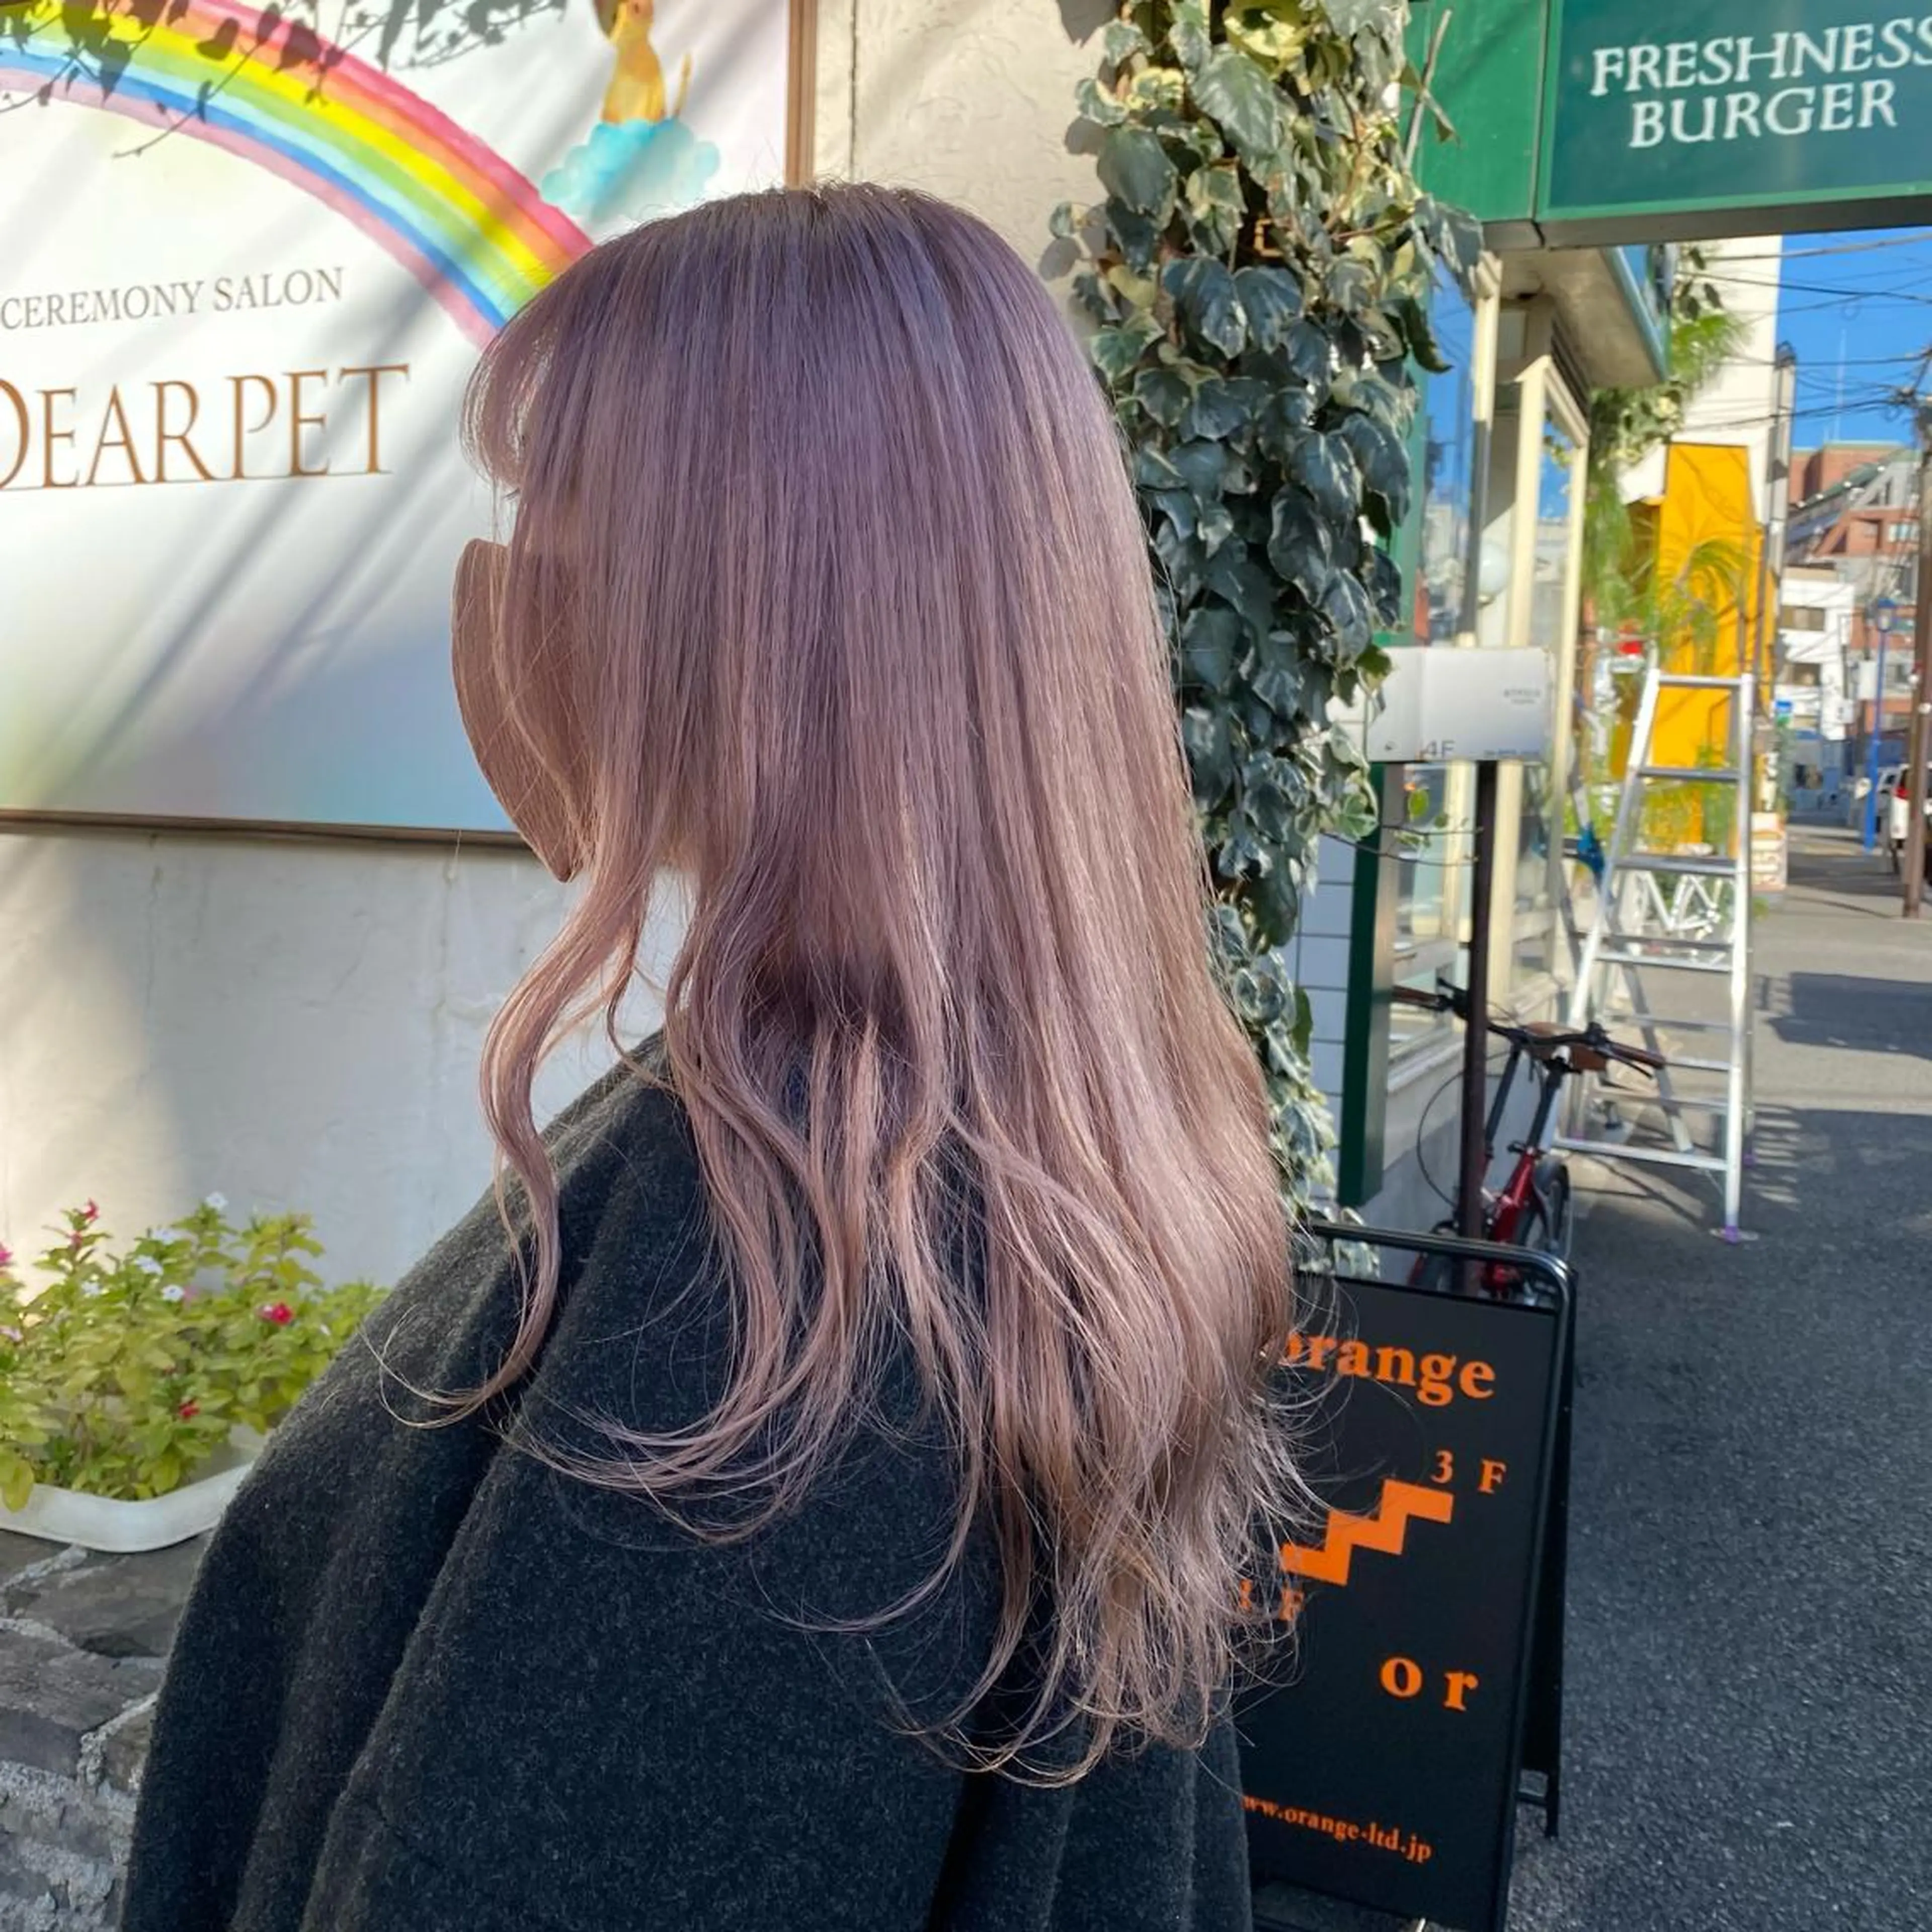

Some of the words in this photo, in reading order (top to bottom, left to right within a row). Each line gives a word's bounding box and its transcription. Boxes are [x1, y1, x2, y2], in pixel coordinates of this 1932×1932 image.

[1628, 78, 1898, 148] BURGER
[0, 279, 205, 331] CEREMONY
[212, 266, 345, 312] SALON
